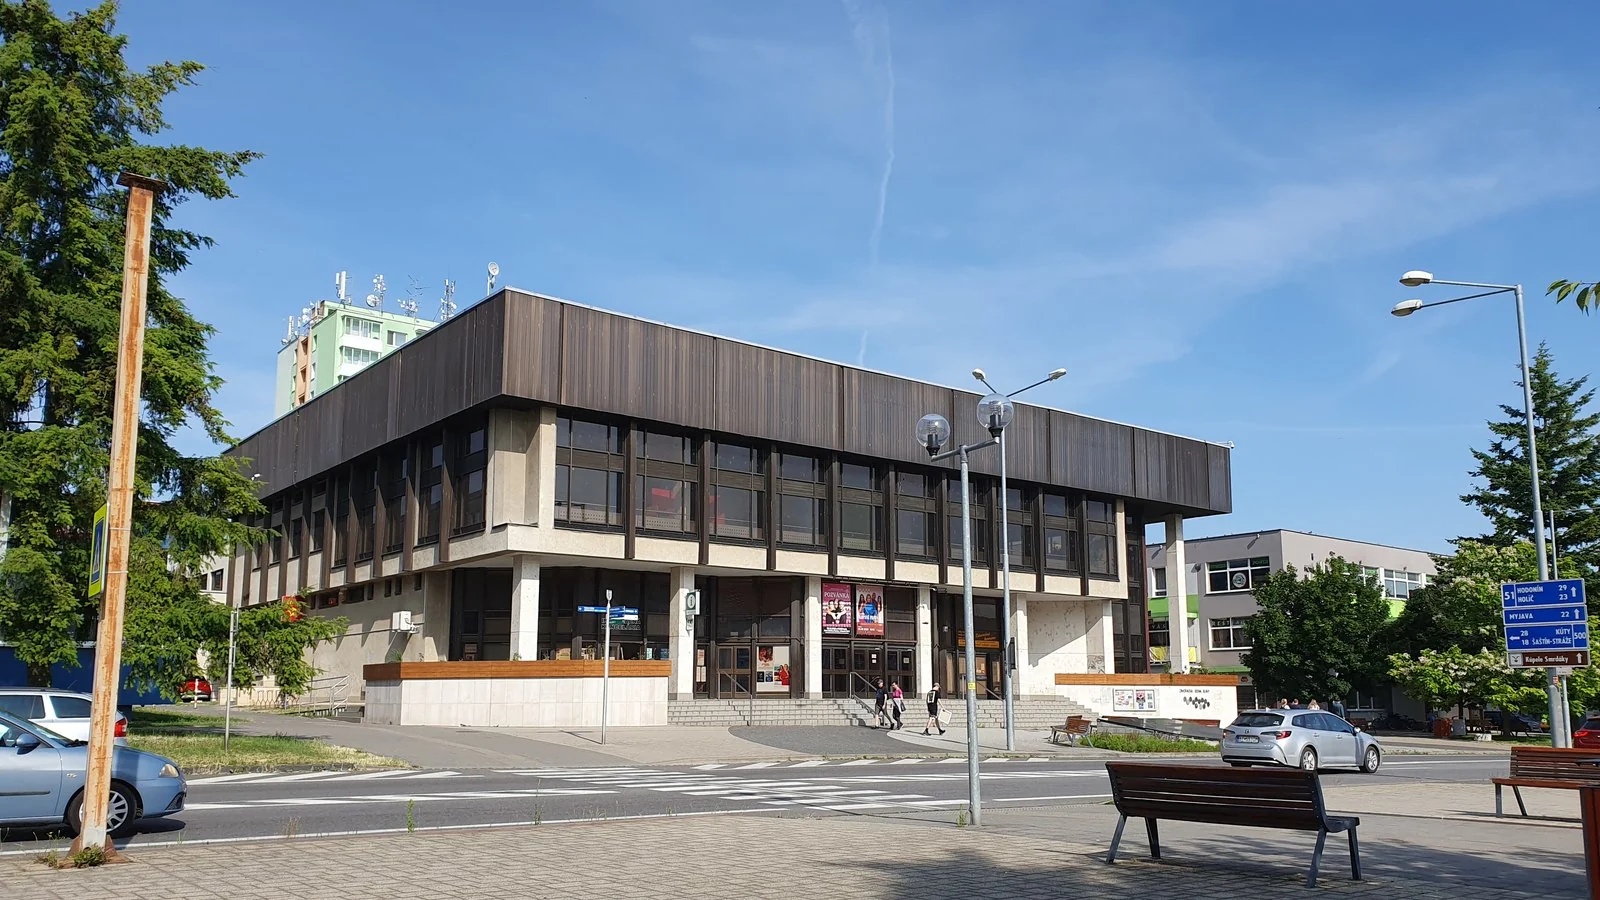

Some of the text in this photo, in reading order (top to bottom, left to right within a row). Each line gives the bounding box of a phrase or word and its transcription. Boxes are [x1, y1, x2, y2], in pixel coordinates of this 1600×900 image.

[1517, 585, 1543, 594] HODONÍN
[1504, 592, 1514, 600] 51
[1518, 594, 1534, 602] HOLÍČ
[1556, 627, 1570, 635] KÚTY
[1532, 637, 1572, 646] ŠAŠTÍN-STRÁŽE
